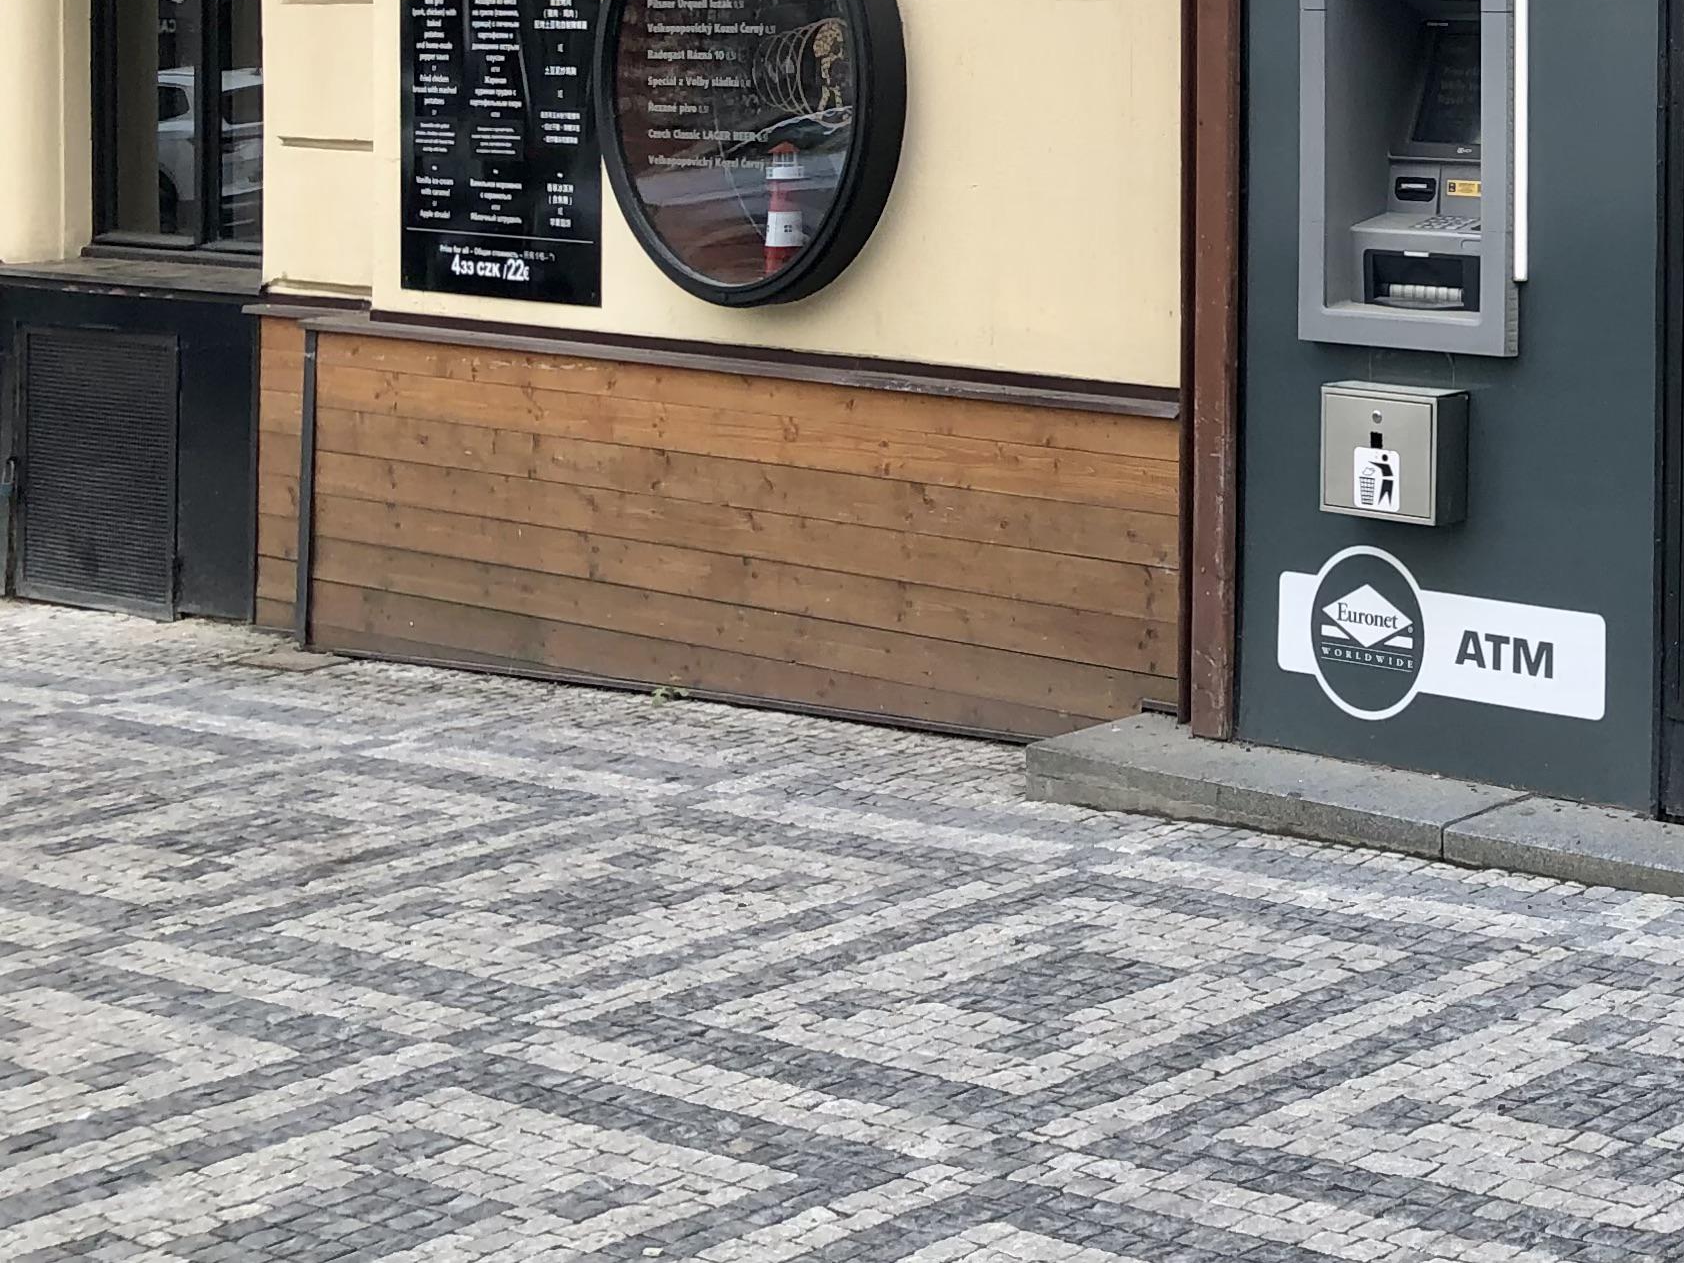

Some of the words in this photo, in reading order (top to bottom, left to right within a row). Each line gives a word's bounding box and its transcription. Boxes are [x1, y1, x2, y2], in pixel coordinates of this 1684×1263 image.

[451, 253, 474, 275] 433
[476, 261, 500, 278] CZK
[1337, 601, 1398, 630] Euronet
[1321, 646, 1414, 669] WORLDWIDE
[1455, 630, 1554, 679] ATM
